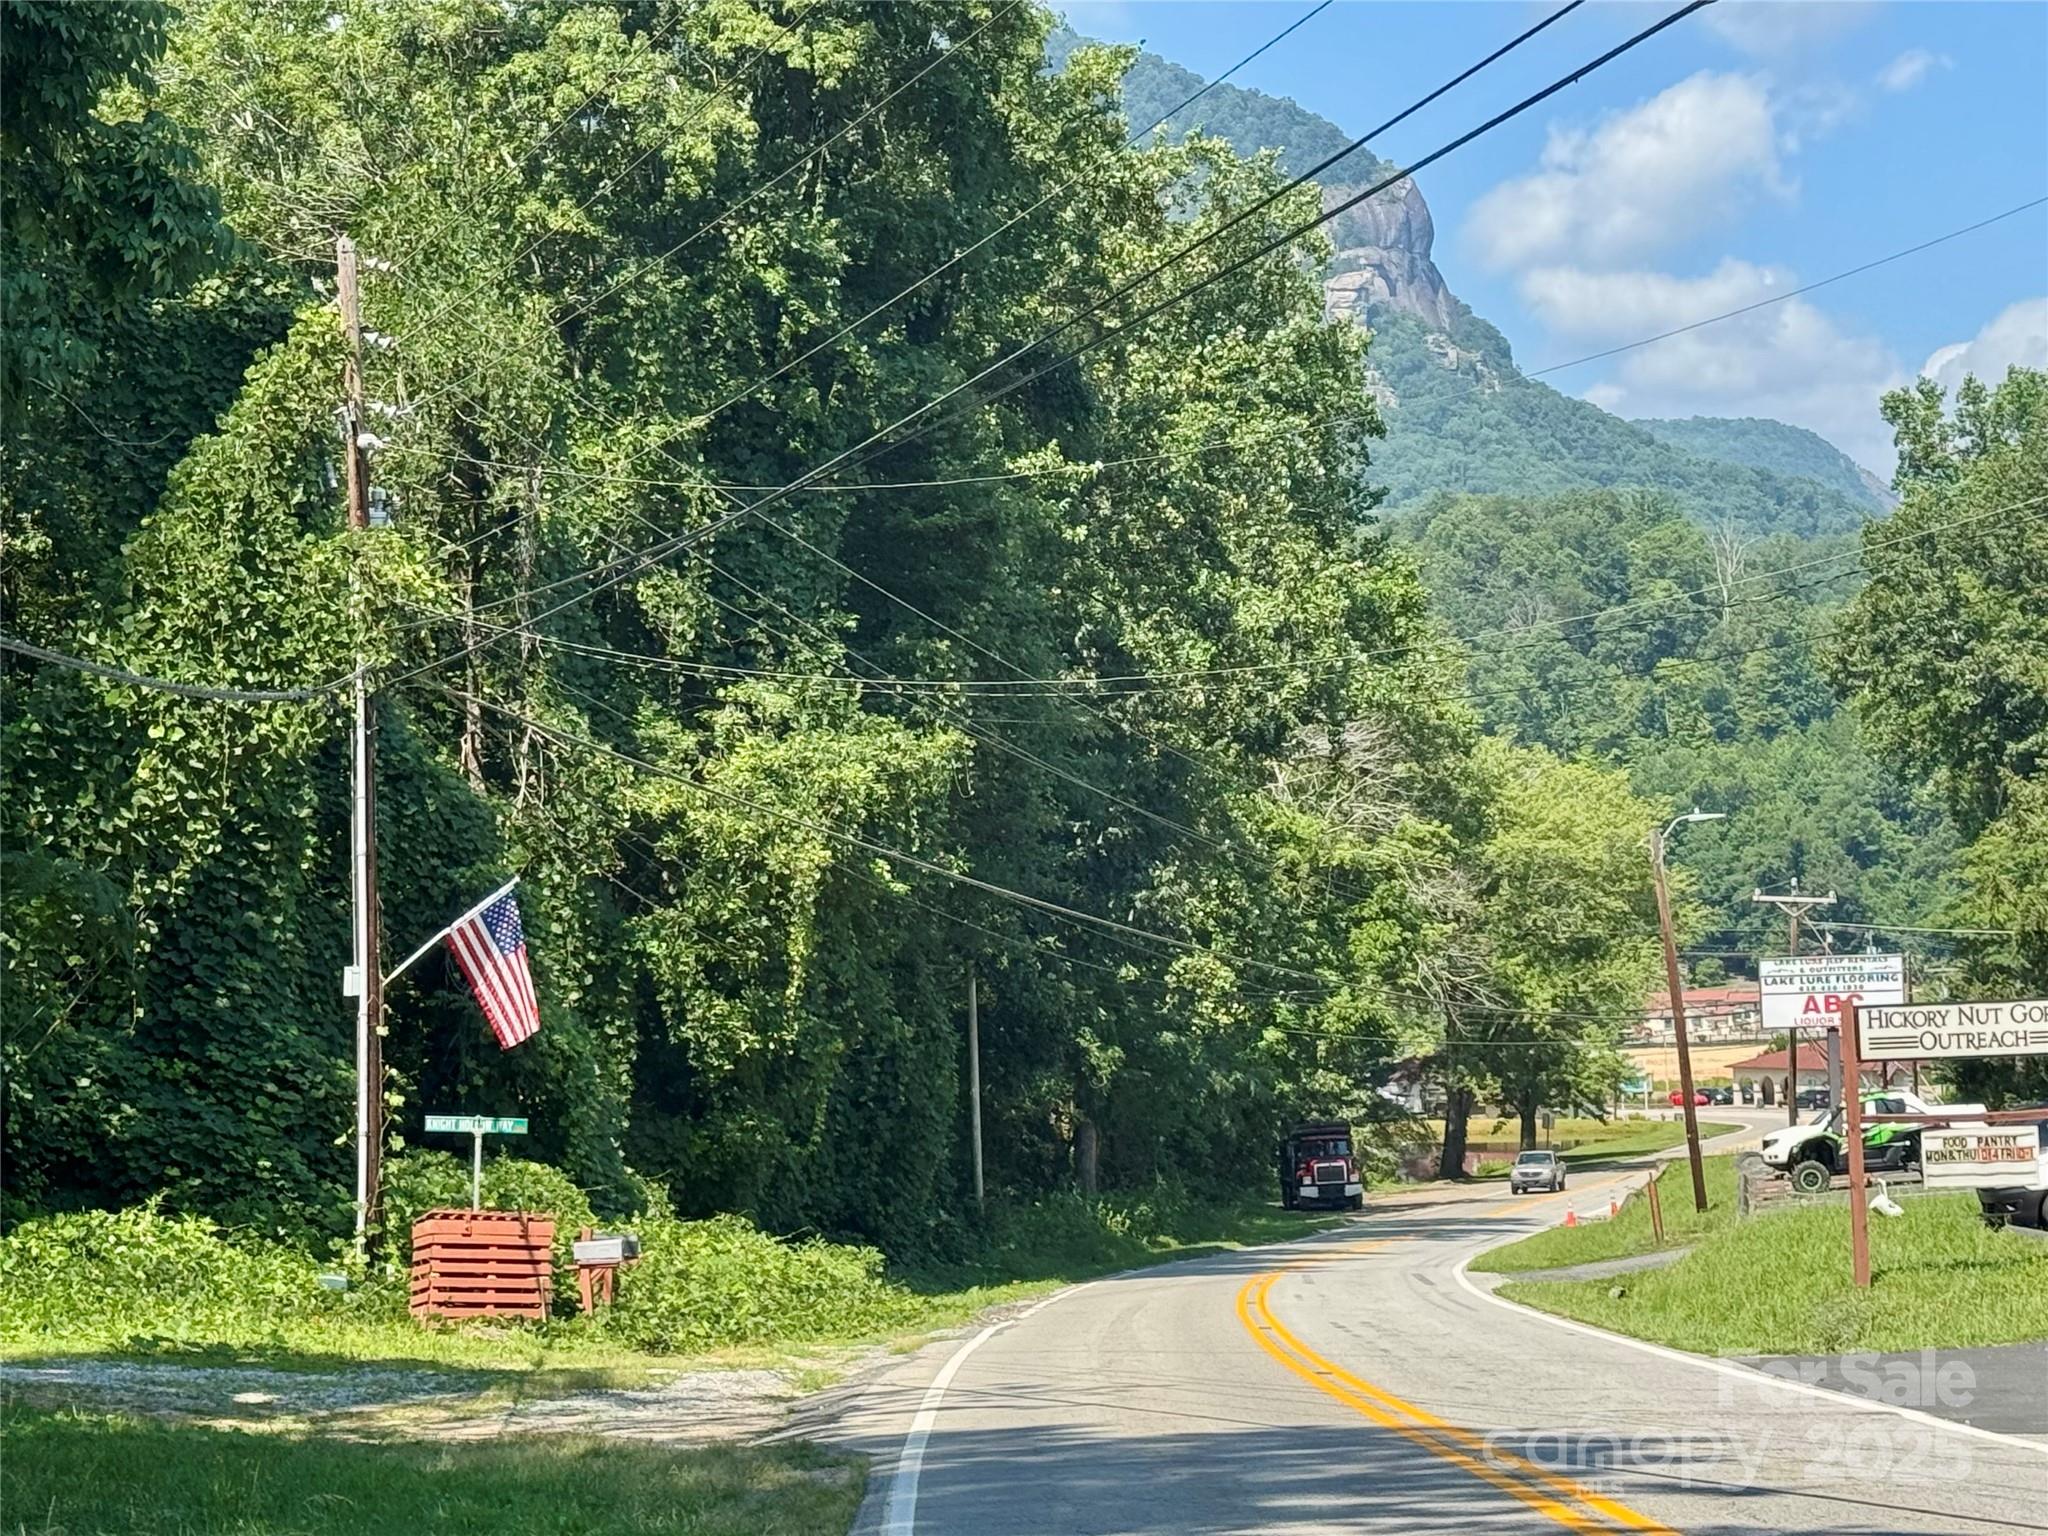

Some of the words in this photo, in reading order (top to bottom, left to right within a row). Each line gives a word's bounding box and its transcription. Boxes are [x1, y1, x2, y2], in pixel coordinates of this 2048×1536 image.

[1764, 976, 1795, 986] LAKE
[1800, 975, 1831, 985] LURE
[1836, 973, 1899, 985] FLOORING
[1794, 1016, 1835, 1025] LIQUOR
[1867, 1008, 1950, 1029] HICKORY
[1958, 1005, 2003, 1026] NUT
[1920, 1030, 2029, 1051] OUTREACH
[1943, 1136, 1968, 1149] FOOD
[1977, 1135, 2018, 1147] PANTRY
